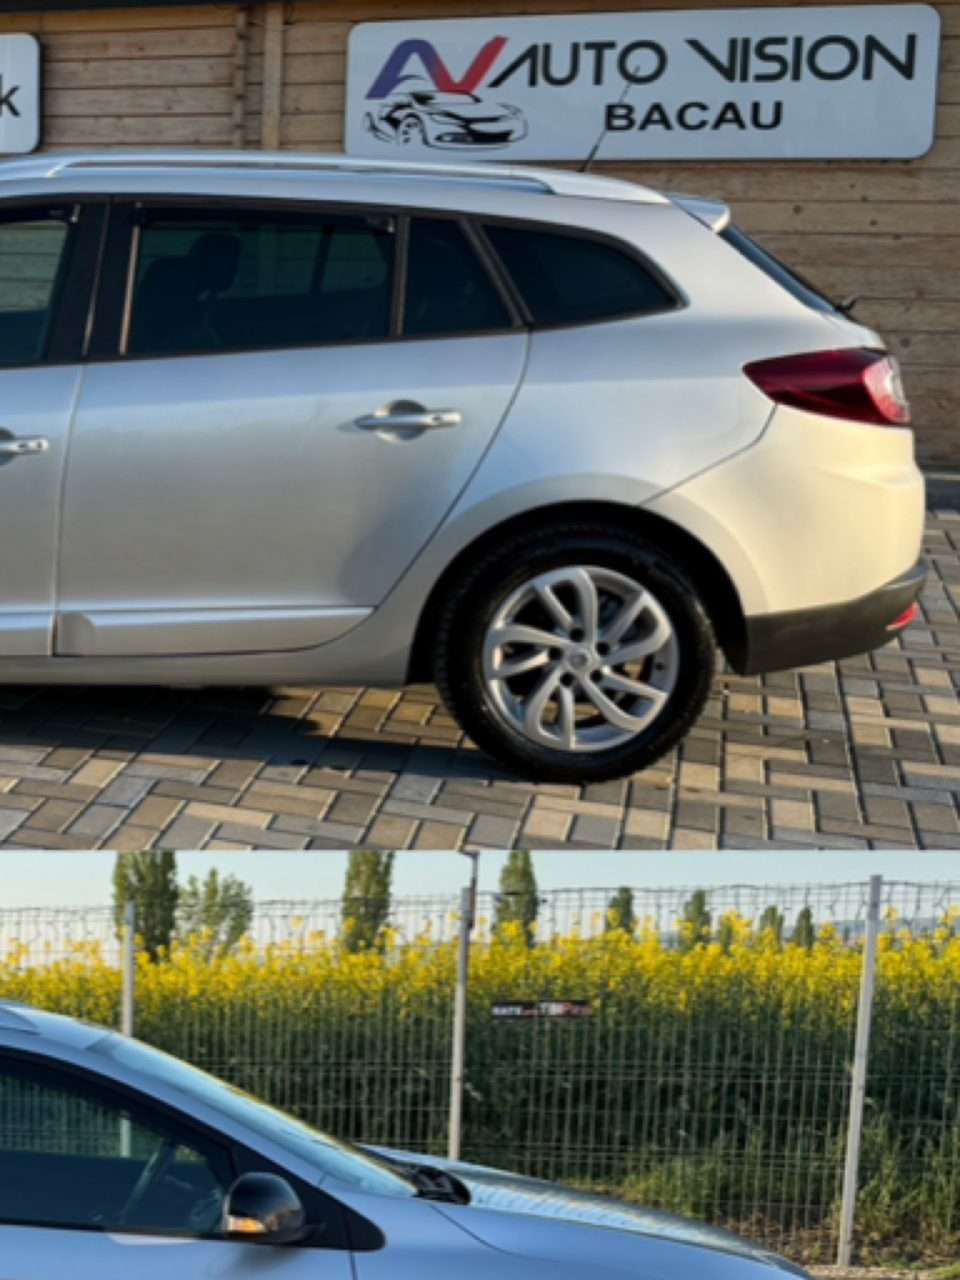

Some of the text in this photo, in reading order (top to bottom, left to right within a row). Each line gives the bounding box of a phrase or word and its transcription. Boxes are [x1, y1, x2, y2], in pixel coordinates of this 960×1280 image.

[488, 39, 668, 88] AUTO
[685, 33, 918, 83] VISION
[603, 100, 784, 132] BACAU
